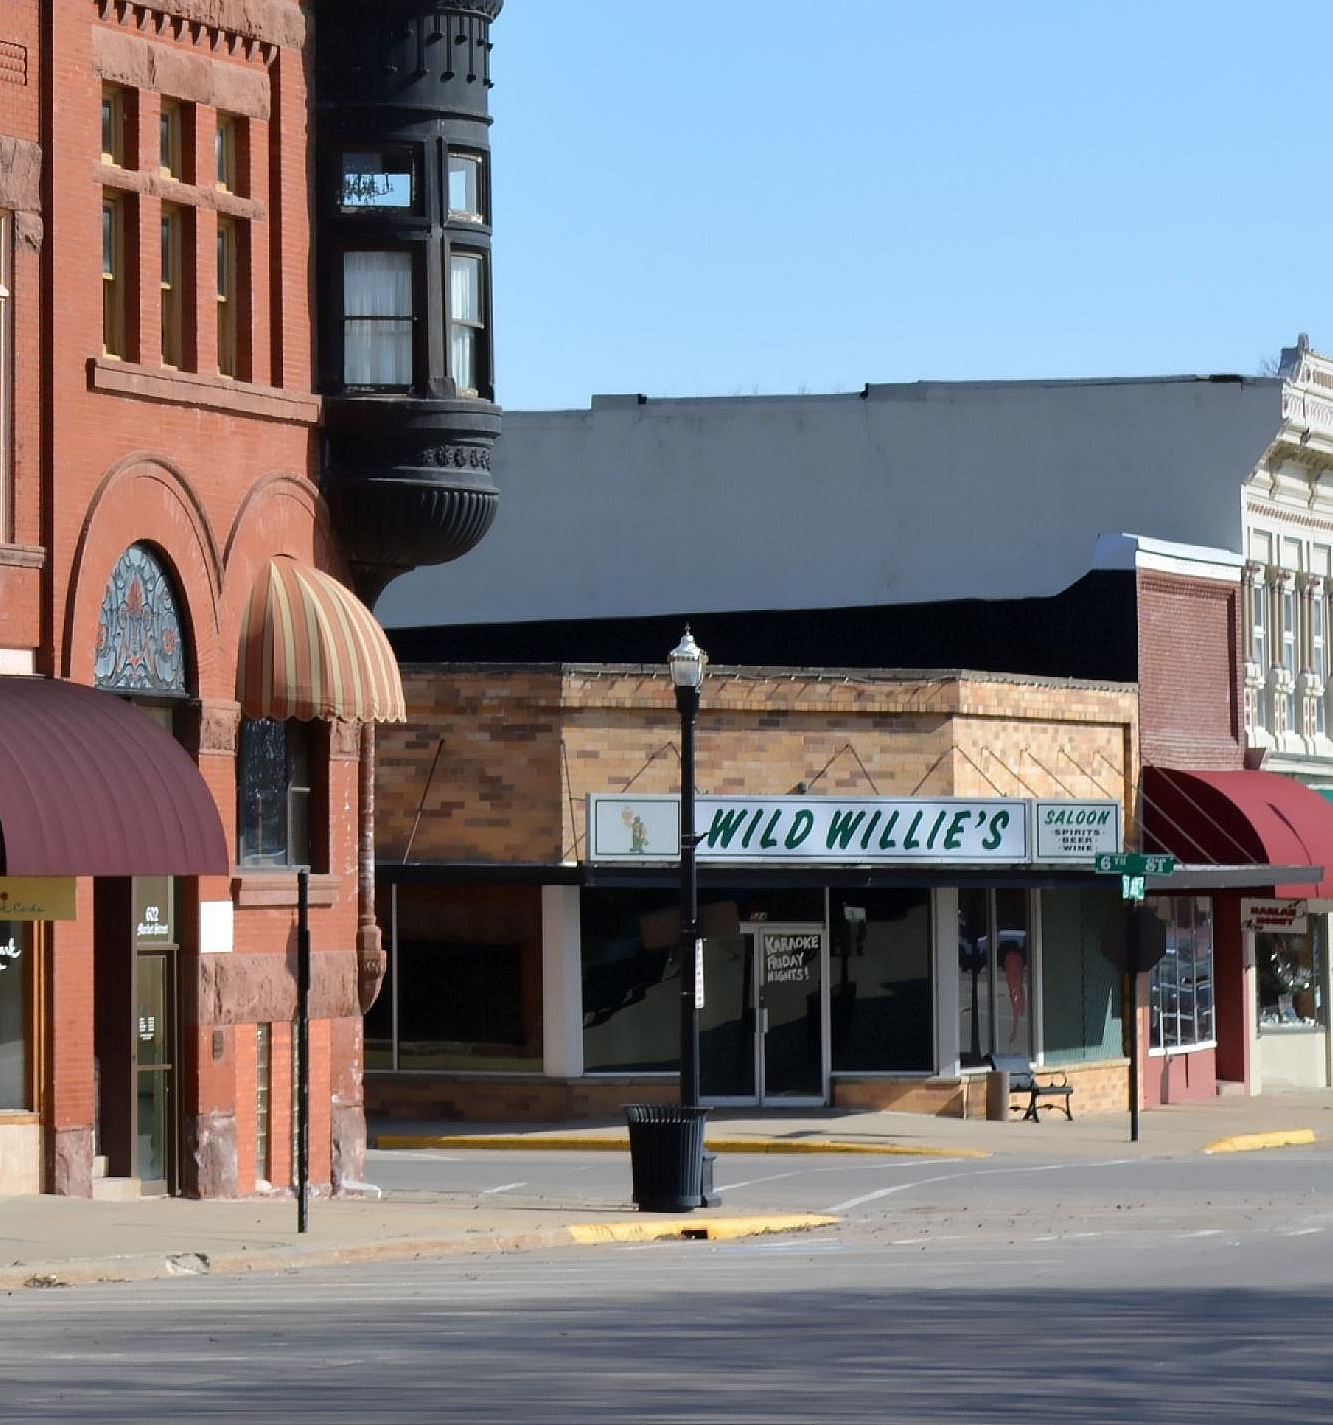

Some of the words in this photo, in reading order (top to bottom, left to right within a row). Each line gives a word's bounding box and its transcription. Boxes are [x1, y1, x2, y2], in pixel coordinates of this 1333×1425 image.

[1044, 809, 1110, 825] SALOON
[708, 809, 814, 850] WILD
[826, 809, 1010, 850] WILLIE'S
[764, 935, 819, 955] KARAOKE
[767, 952, 804, 971] FRIDAY
